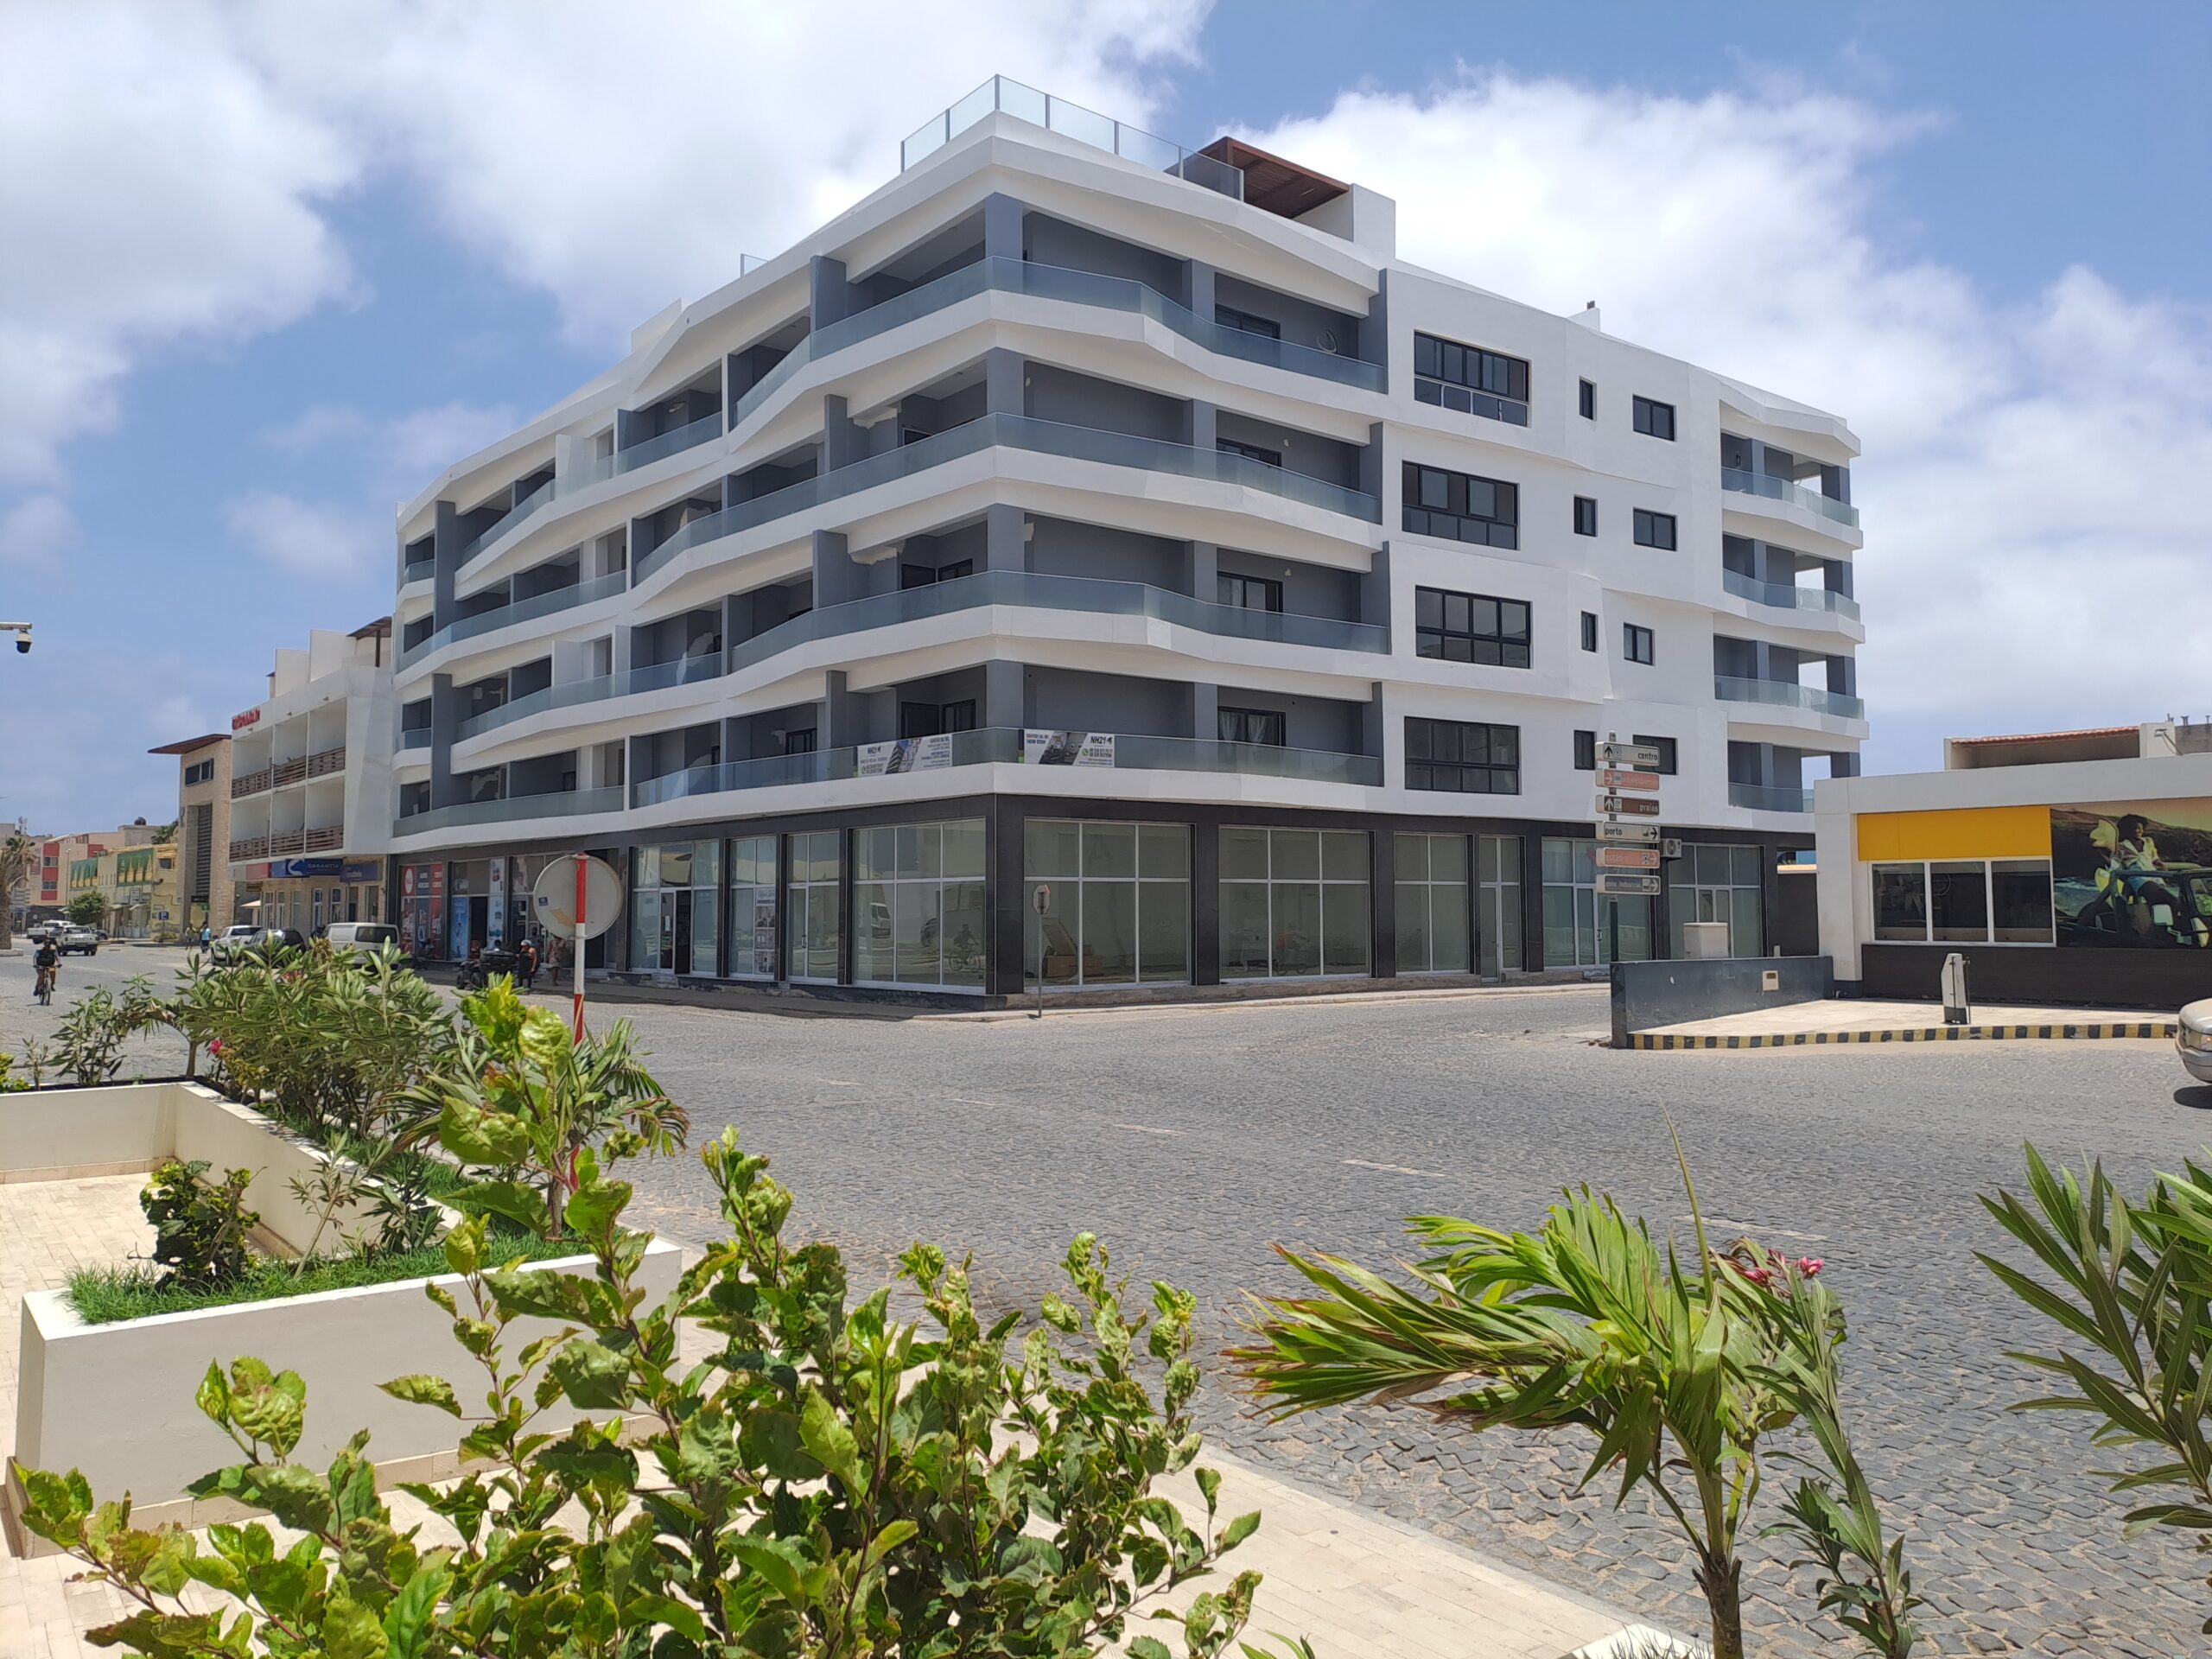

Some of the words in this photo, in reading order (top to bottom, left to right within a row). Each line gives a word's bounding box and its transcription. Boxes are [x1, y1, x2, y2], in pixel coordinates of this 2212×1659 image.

[1637, 752, 1658, 761] centro
[1639, 803, 1658, 813] praias
[1605, 827, 1623, 836] porto
